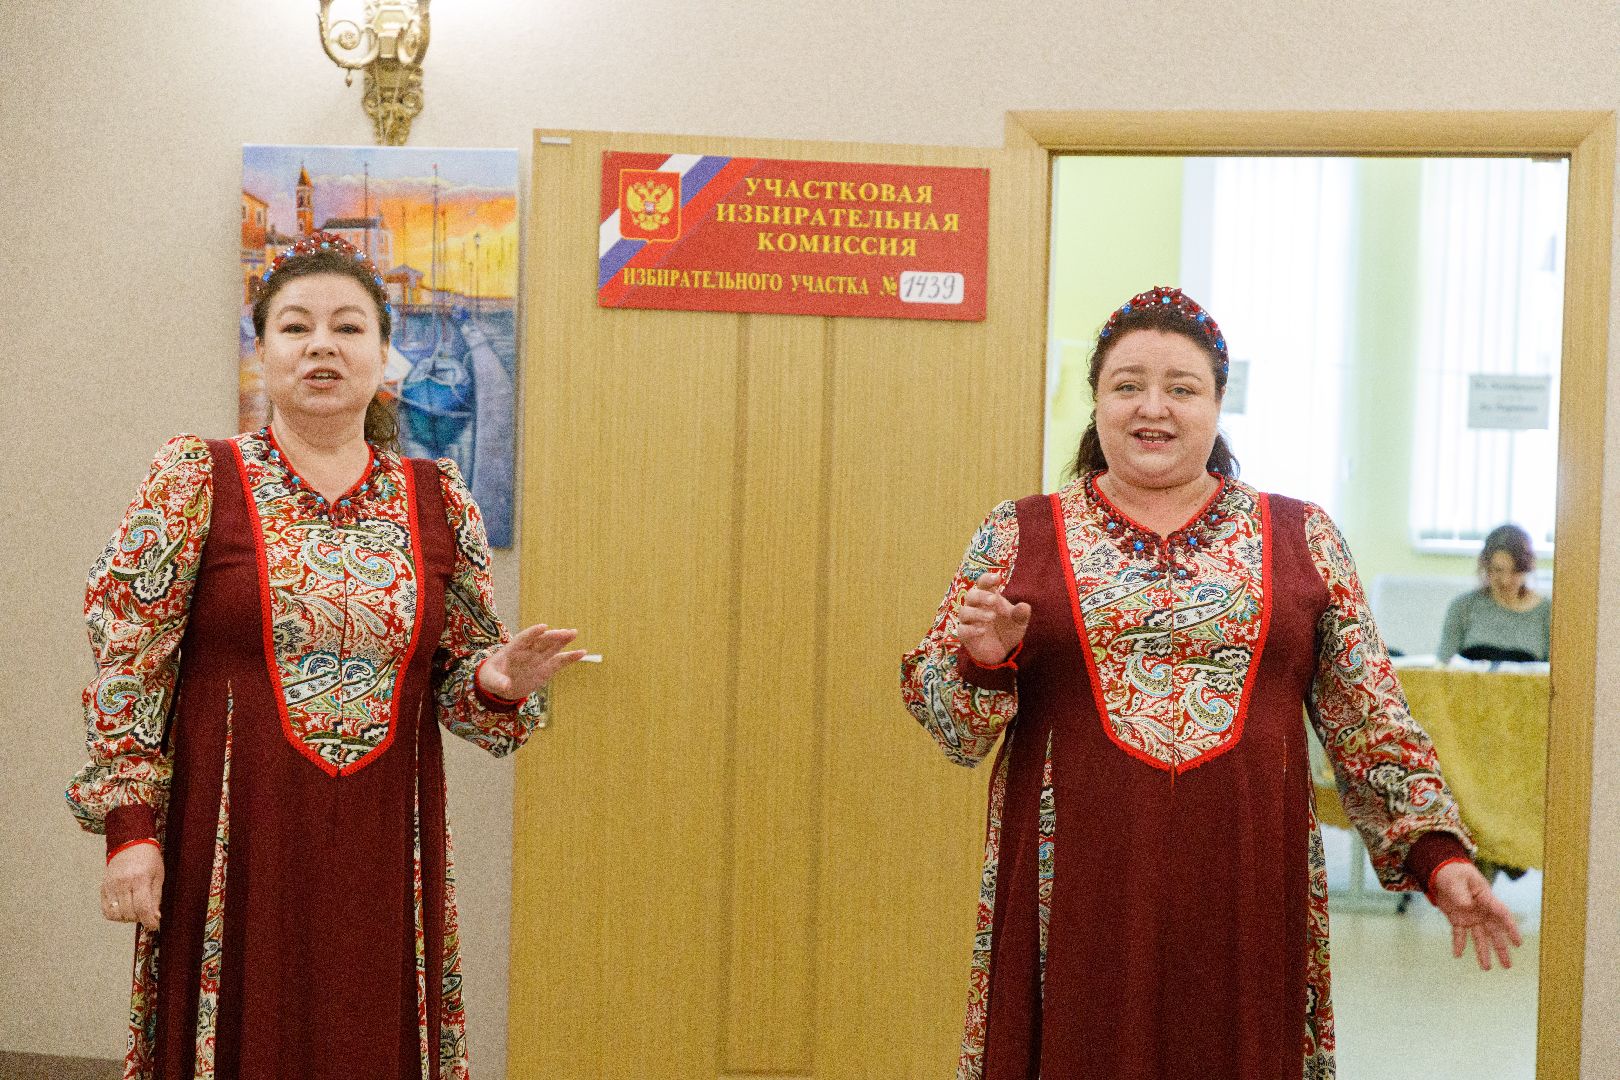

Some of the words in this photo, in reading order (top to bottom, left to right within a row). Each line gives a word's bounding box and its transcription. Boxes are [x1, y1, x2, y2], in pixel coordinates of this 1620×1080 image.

[745, 177, 934, 204] УЧАСТКОВАЯ
[717, 203, 960, 232] ИЗБИРАТЕЛЬНАЯ
[758, 232, 918, 257] КОМИССИЯ
[623, 267, 783, 292] ИЗБИРАТЕЛЬНОГО
[791, 272, 869, 295] УЧАСТКА
[879, 273, 897, 297] №
[903, 274, 956, 300] 1439
